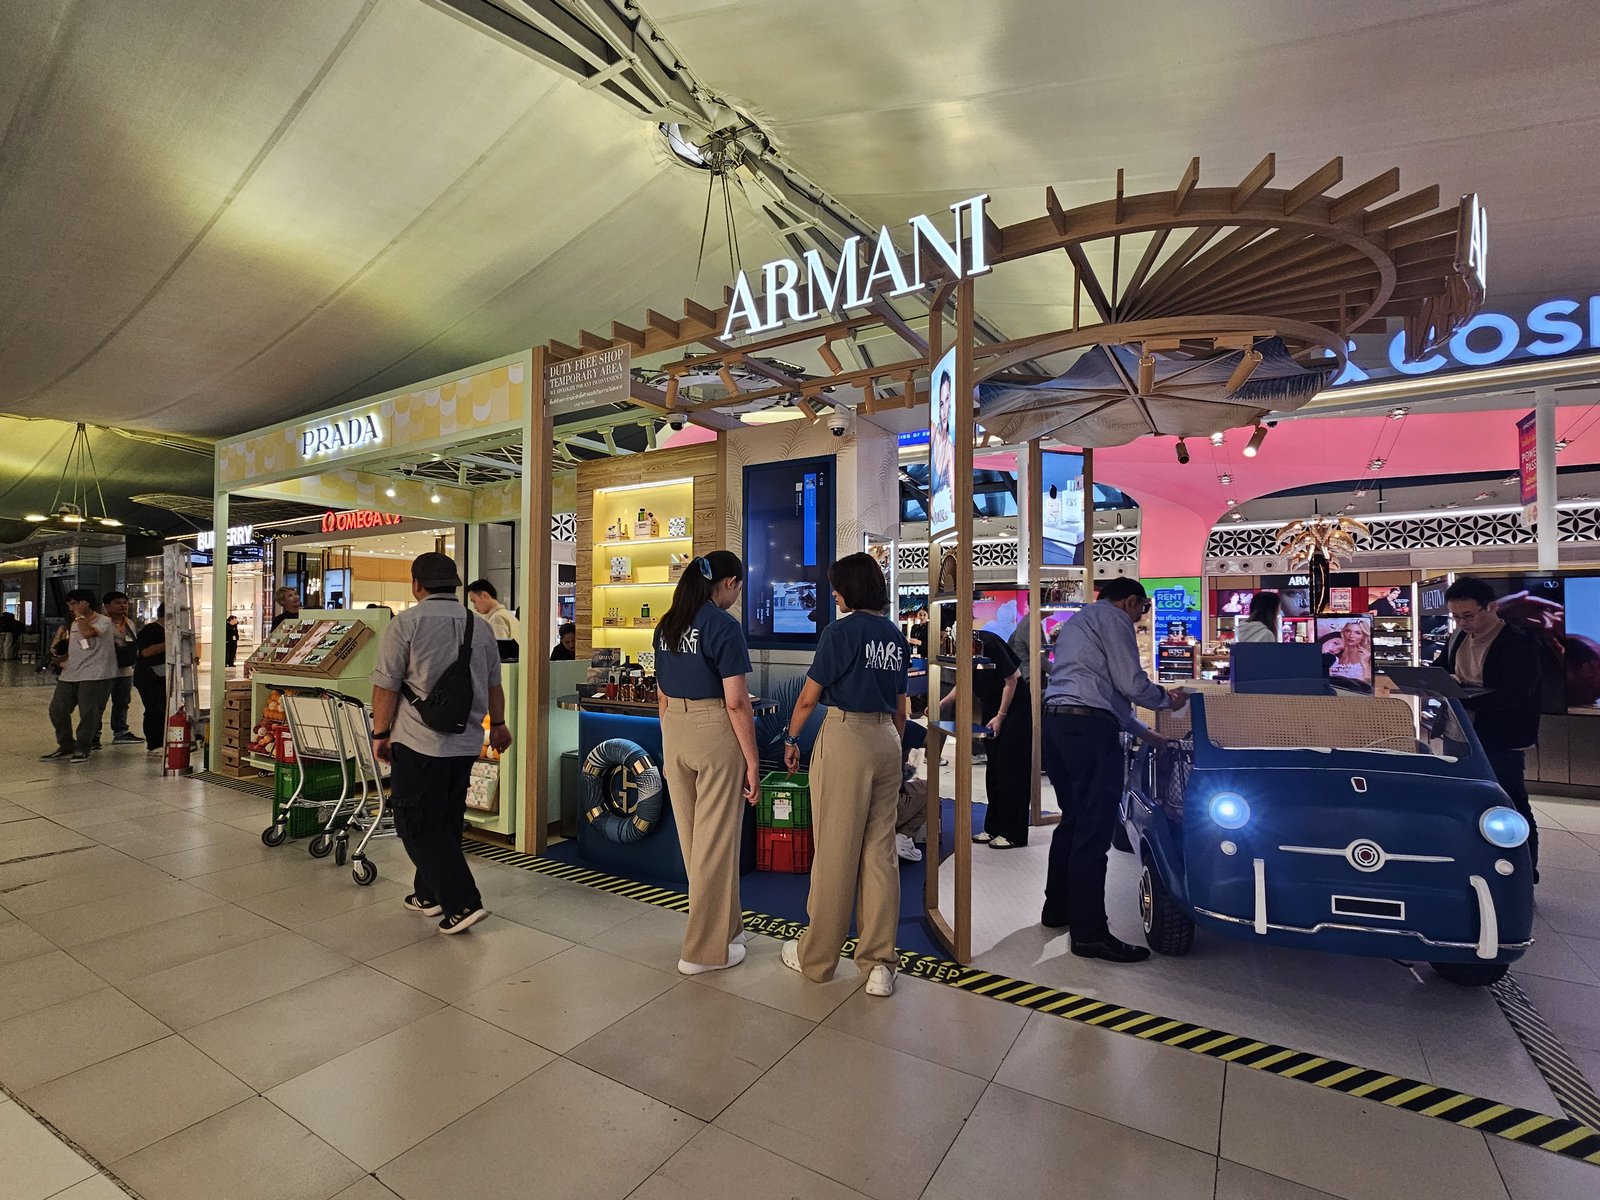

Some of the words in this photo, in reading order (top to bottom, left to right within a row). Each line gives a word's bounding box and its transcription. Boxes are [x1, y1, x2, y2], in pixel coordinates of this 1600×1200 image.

[720, 194, 991, 341] ARMANI
[1389, 296, 1600, 375] COS
[550, 362, 573, 377] DUTY
[575, 355, 597, 371] FREE
[599, 348, 623, 365] SHOP
[549, 367, 598, 388] TEMPORARY
[600, 362, 623, 377] AREA
[302, 415, 378, 455] PRADA
[336, 510, 383, 531] OMEGA
[908, 585, 929, 595] FOR
[1288, 576, 1310, 586] ARM
[1157, 593, 1183, 601] RENT
[1157, 601, 1164, 609] &
[1165, 601, 1183, 609] GO
[865, 640, 903, 661] MARE
[749, 916, 806, 940] PLEASE
[913, 960, 960, 980] STEP
